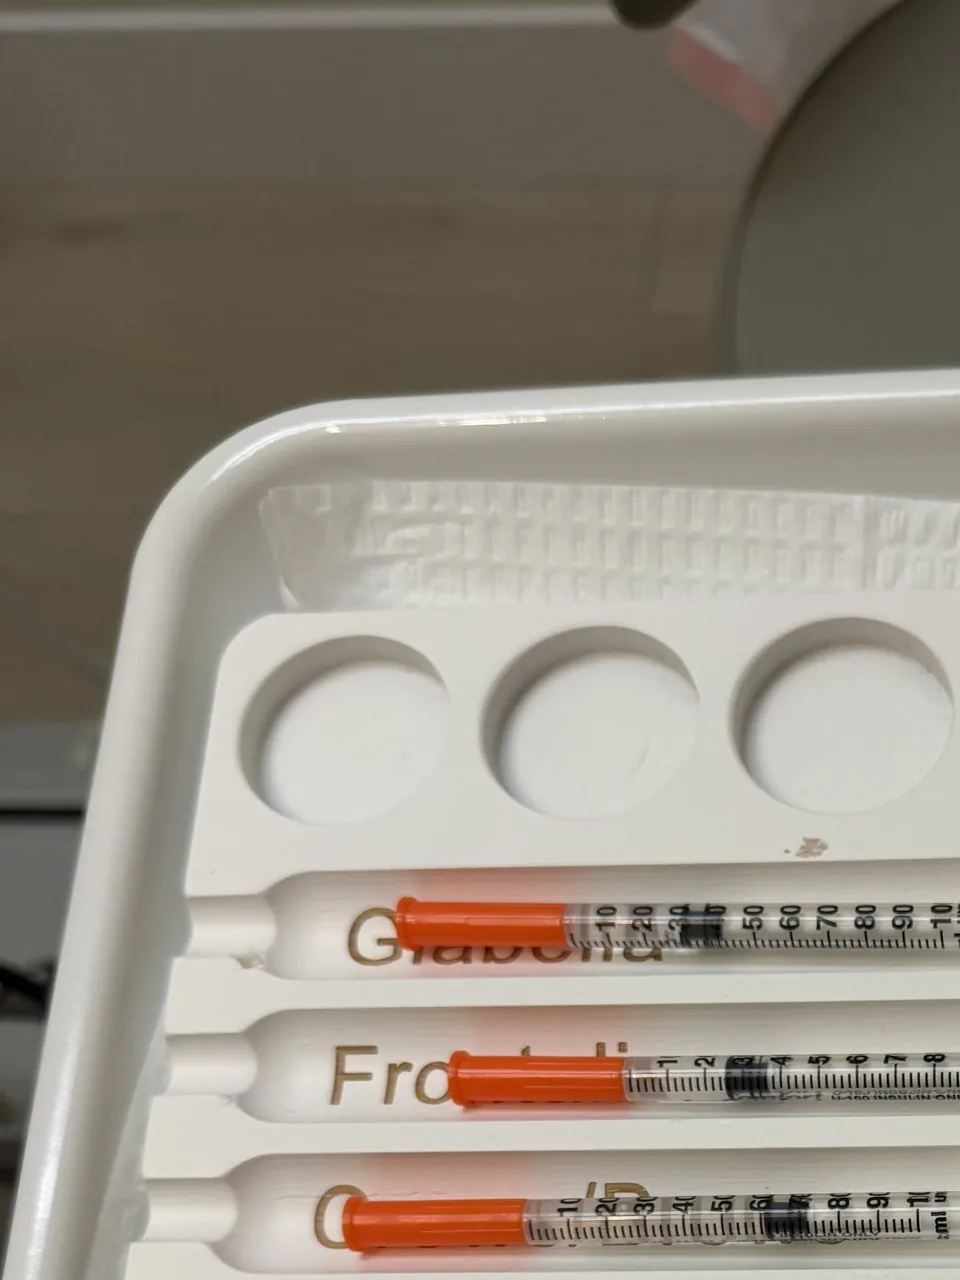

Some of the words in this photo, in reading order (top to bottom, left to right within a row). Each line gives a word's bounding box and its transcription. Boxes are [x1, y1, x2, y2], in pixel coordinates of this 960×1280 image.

[596, 905, 617, 932] 10
[631, 905, 654, 932] 20
[742, 905, 765, 931] 50
[779, 904, 802, 931] 60
[816, 904, 839, 931] 70
[854, 904, 877, 930] 80
[891, 904, 914, 930] 90
